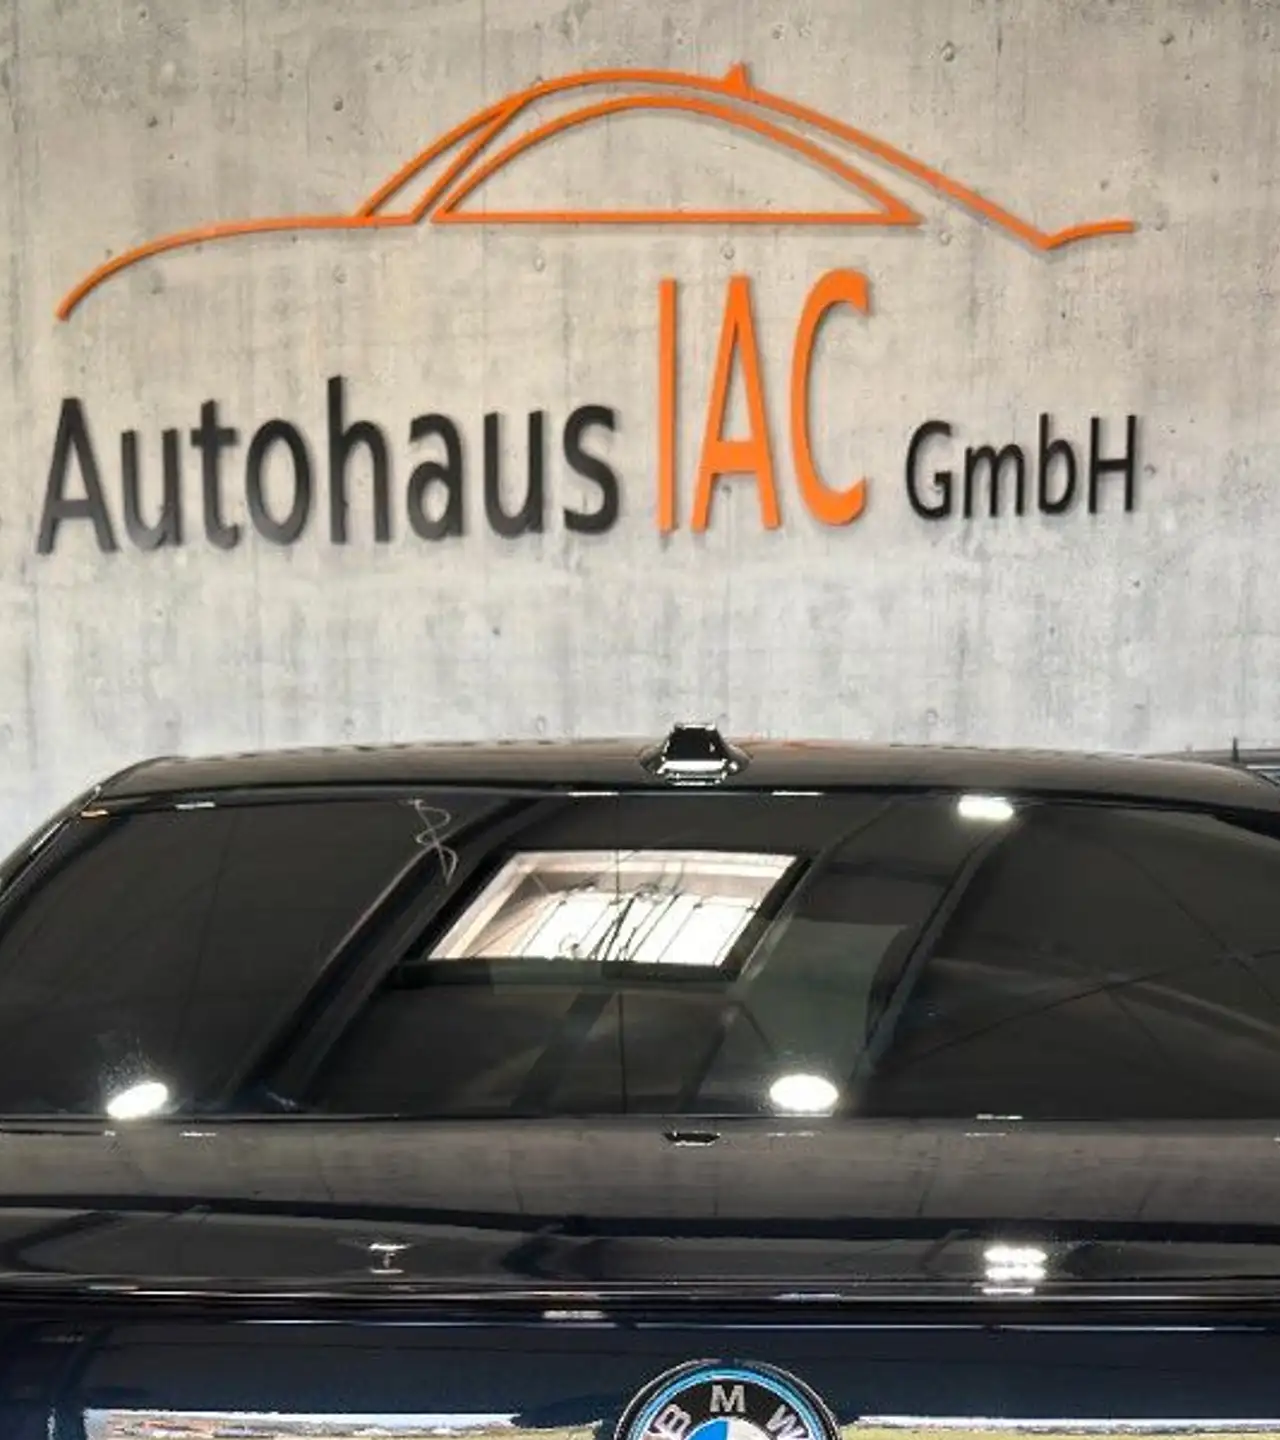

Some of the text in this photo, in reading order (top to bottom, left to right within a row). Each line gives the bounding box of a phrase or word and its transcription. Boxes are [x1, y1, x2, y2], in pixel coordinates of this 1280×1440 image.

[36, 267, 1139, 556] Autohaus IAC GmbH
